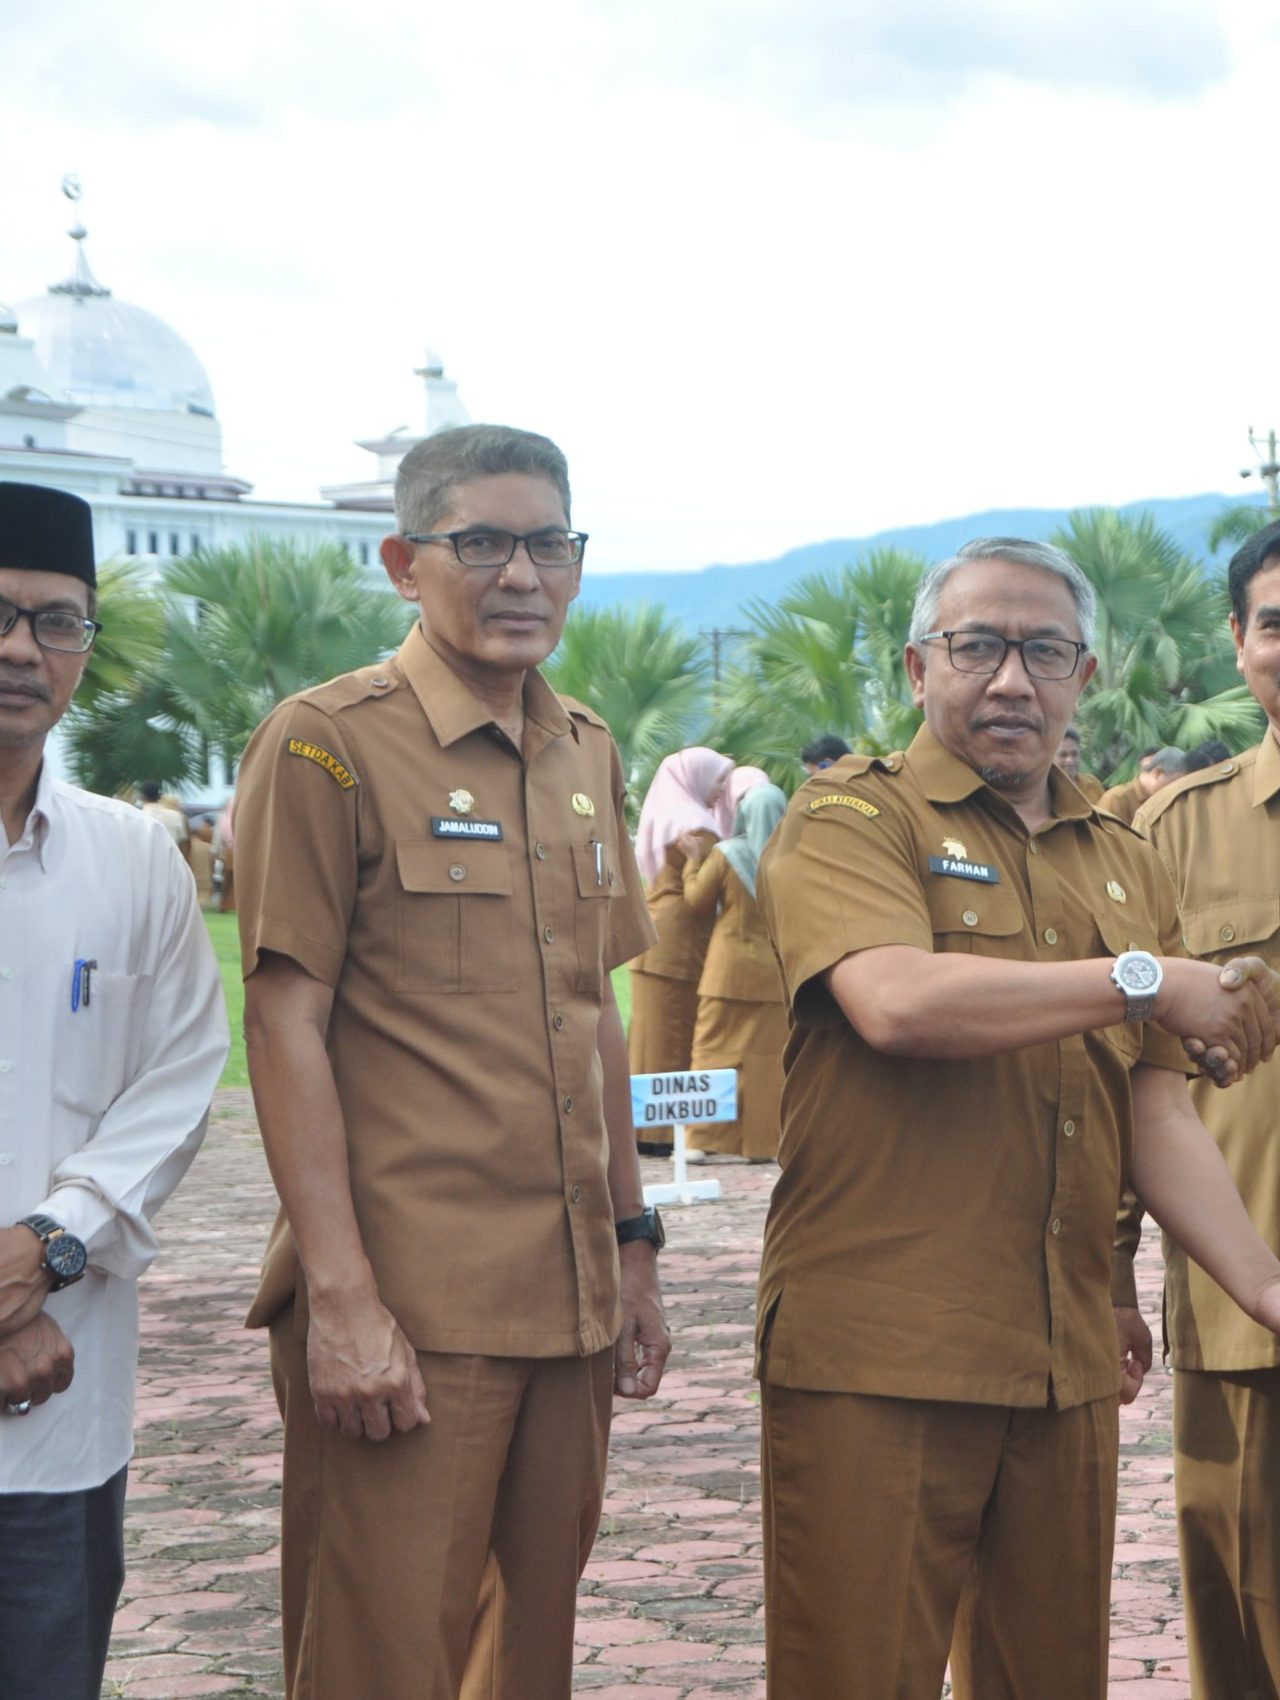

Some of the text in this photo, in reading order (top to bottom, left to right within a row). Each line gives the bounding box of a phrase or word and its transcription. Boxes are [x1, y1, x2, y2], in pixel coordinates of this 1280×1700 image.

[291, 741, 351, 786] SETDA KAB
[439, 820, 499, 835] JAMALUDDIN
[942, 859, 988, 877] FARHAN
[652, 1074, 710, 1095] DINAS
[645, 1099, 717, 1121] DIKBUD
